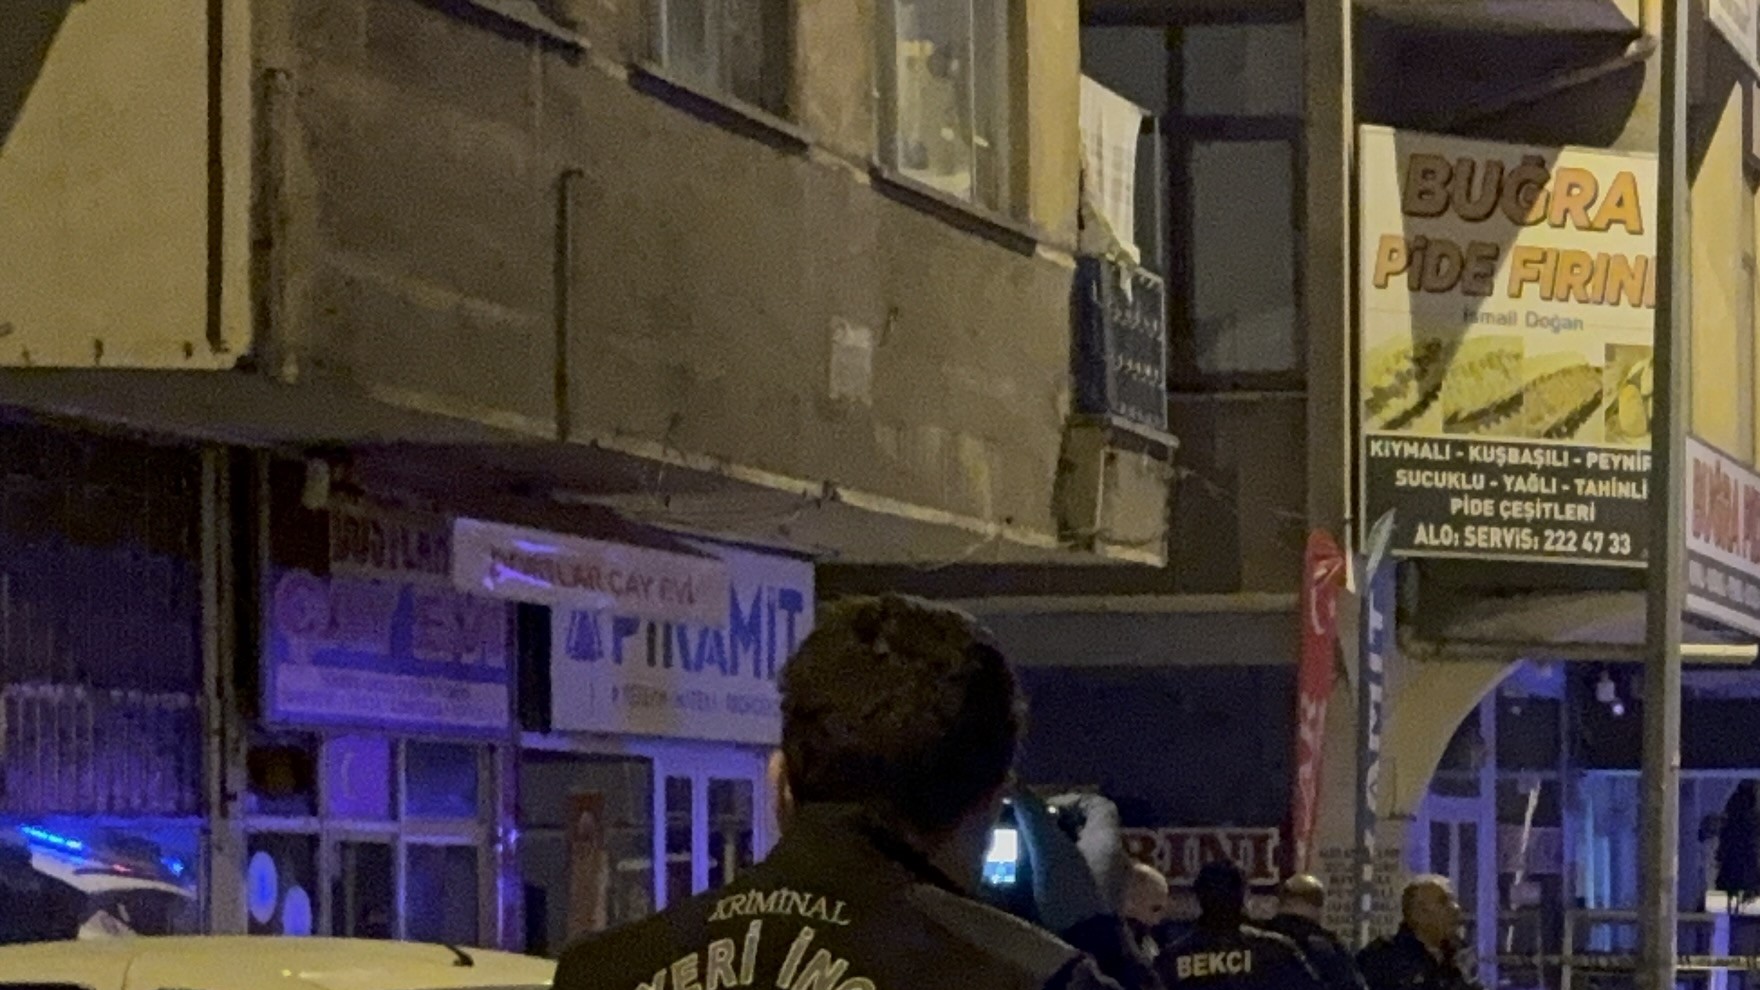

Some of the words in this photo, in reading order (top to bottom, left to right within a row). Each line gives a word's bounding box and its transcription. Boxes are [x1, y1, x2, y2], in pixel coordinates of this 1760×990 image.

[1402, 153, 1645, 236] BUĞRA
[1373, 233, 1499, 297] PİDE
[1370, 440, 1451, 461] KIYMALI
[1468, 445, 1570, 470] KUŞBAŞILI
[1395, 469, 1485, 490] SUCUKLU
[1502, 472, 1557, 494] YAĞLI
[1574, 477, 1648, 499] TAHİNLİ
[1450, 494, 1495, 517] PİDE
[1500, 498, 1596, 523] ÇEŞİTLERİ
[1543, 530, 1578, 551] 222
[1581, 533, 1604, 553] 47
[1608, 533, 1631, 555] 33
